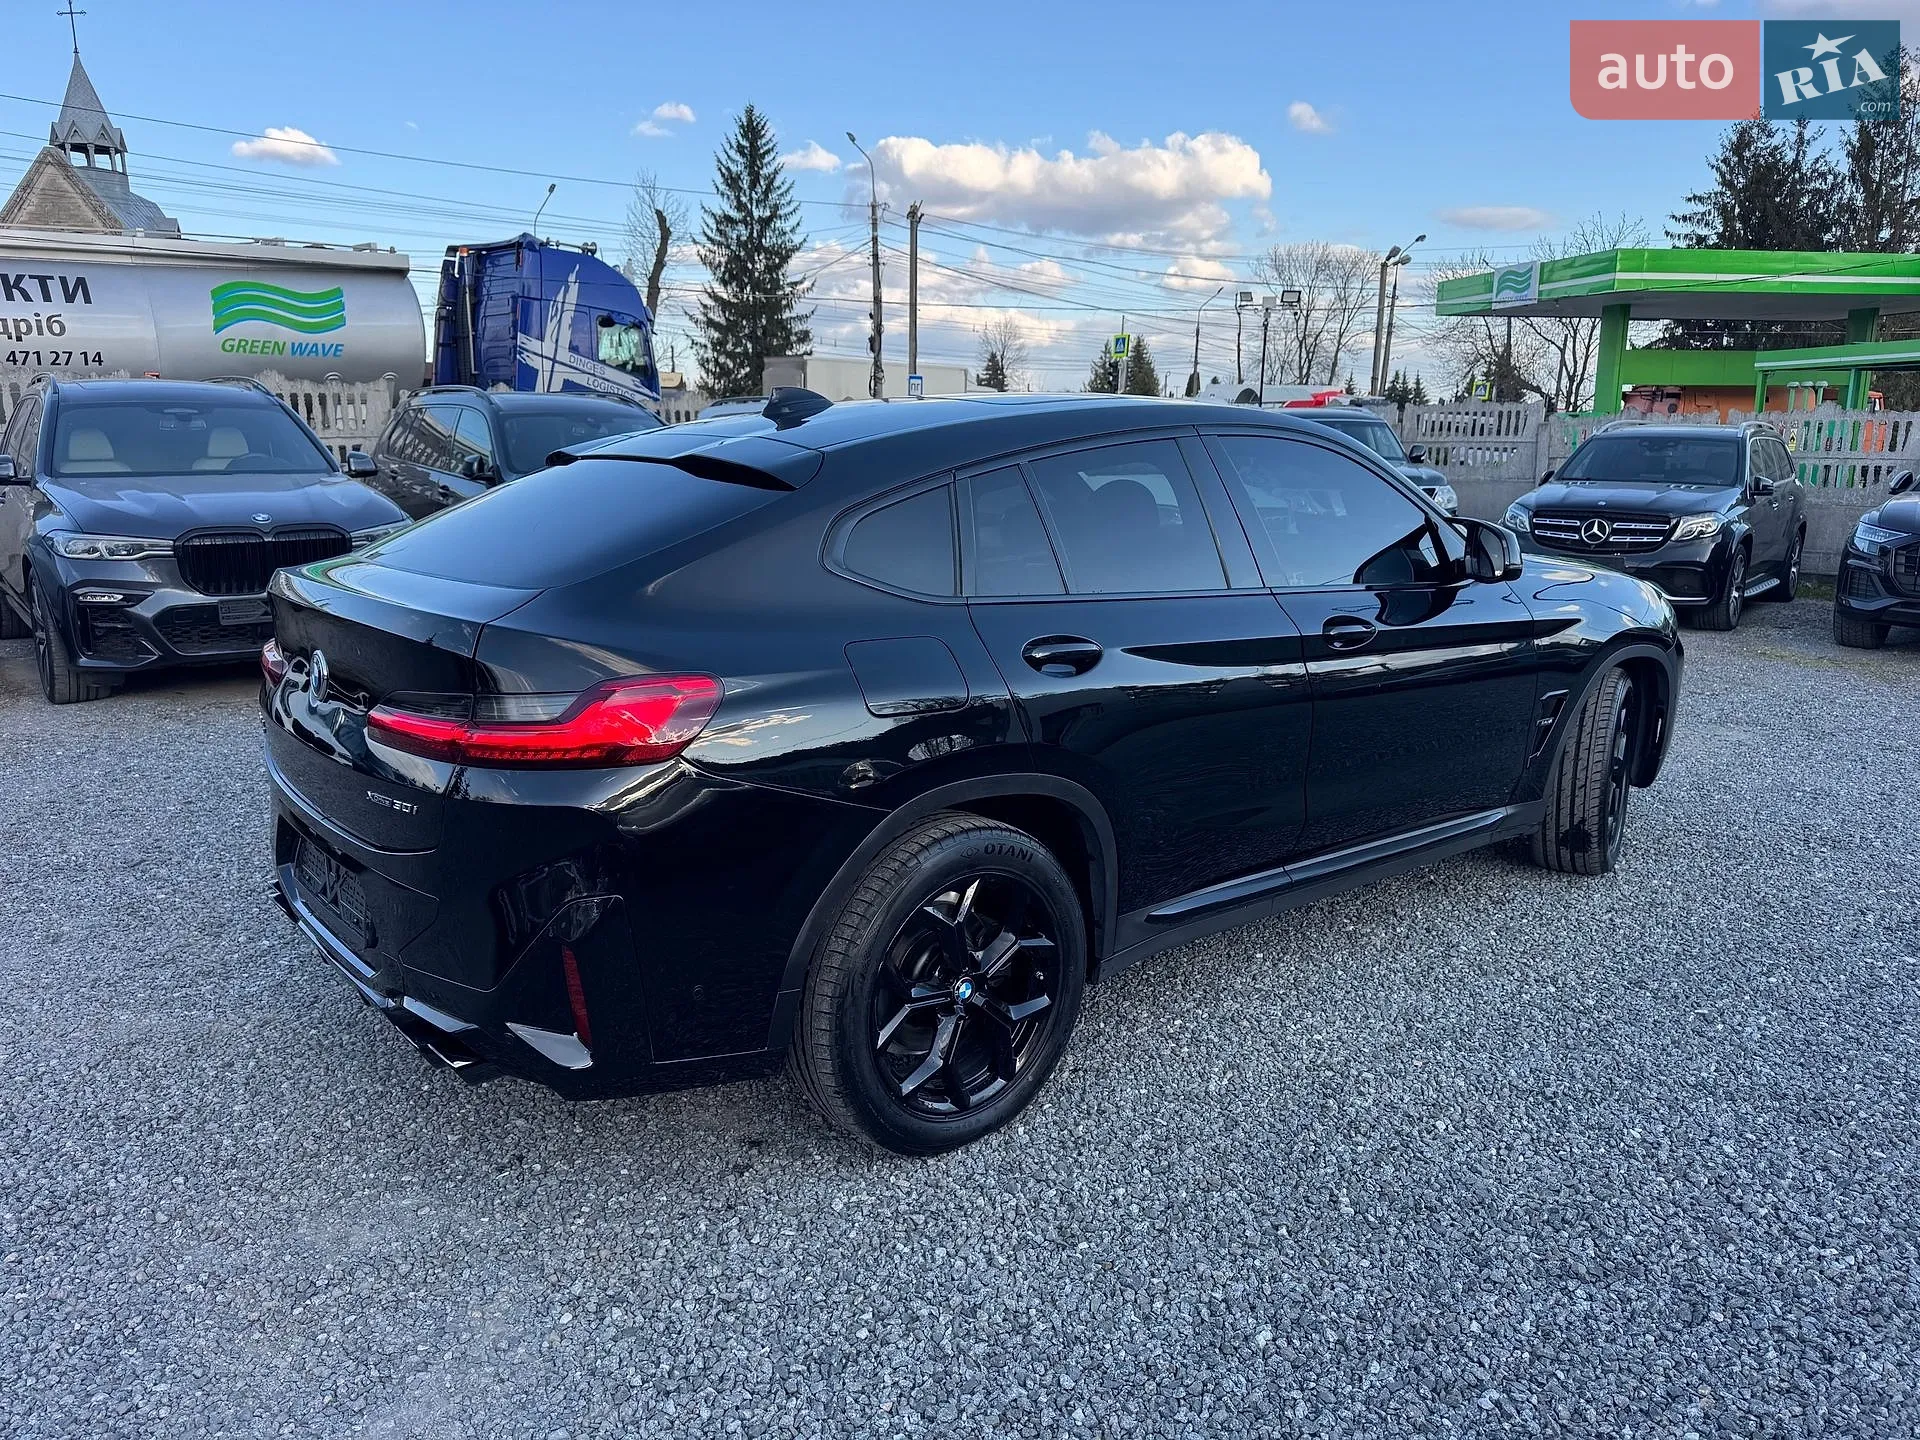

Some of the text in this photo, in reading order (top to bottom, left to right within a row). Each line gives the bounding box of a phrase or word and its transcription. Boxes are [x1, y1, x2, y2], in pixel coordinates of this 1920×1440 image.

[221, 338, 344, 358] GREEN WAVE
[5, 350, 104, 367] 471 27 14
[569, 354, 606, 375] DINGES
[984, 842, 1034, 862] OTANI
